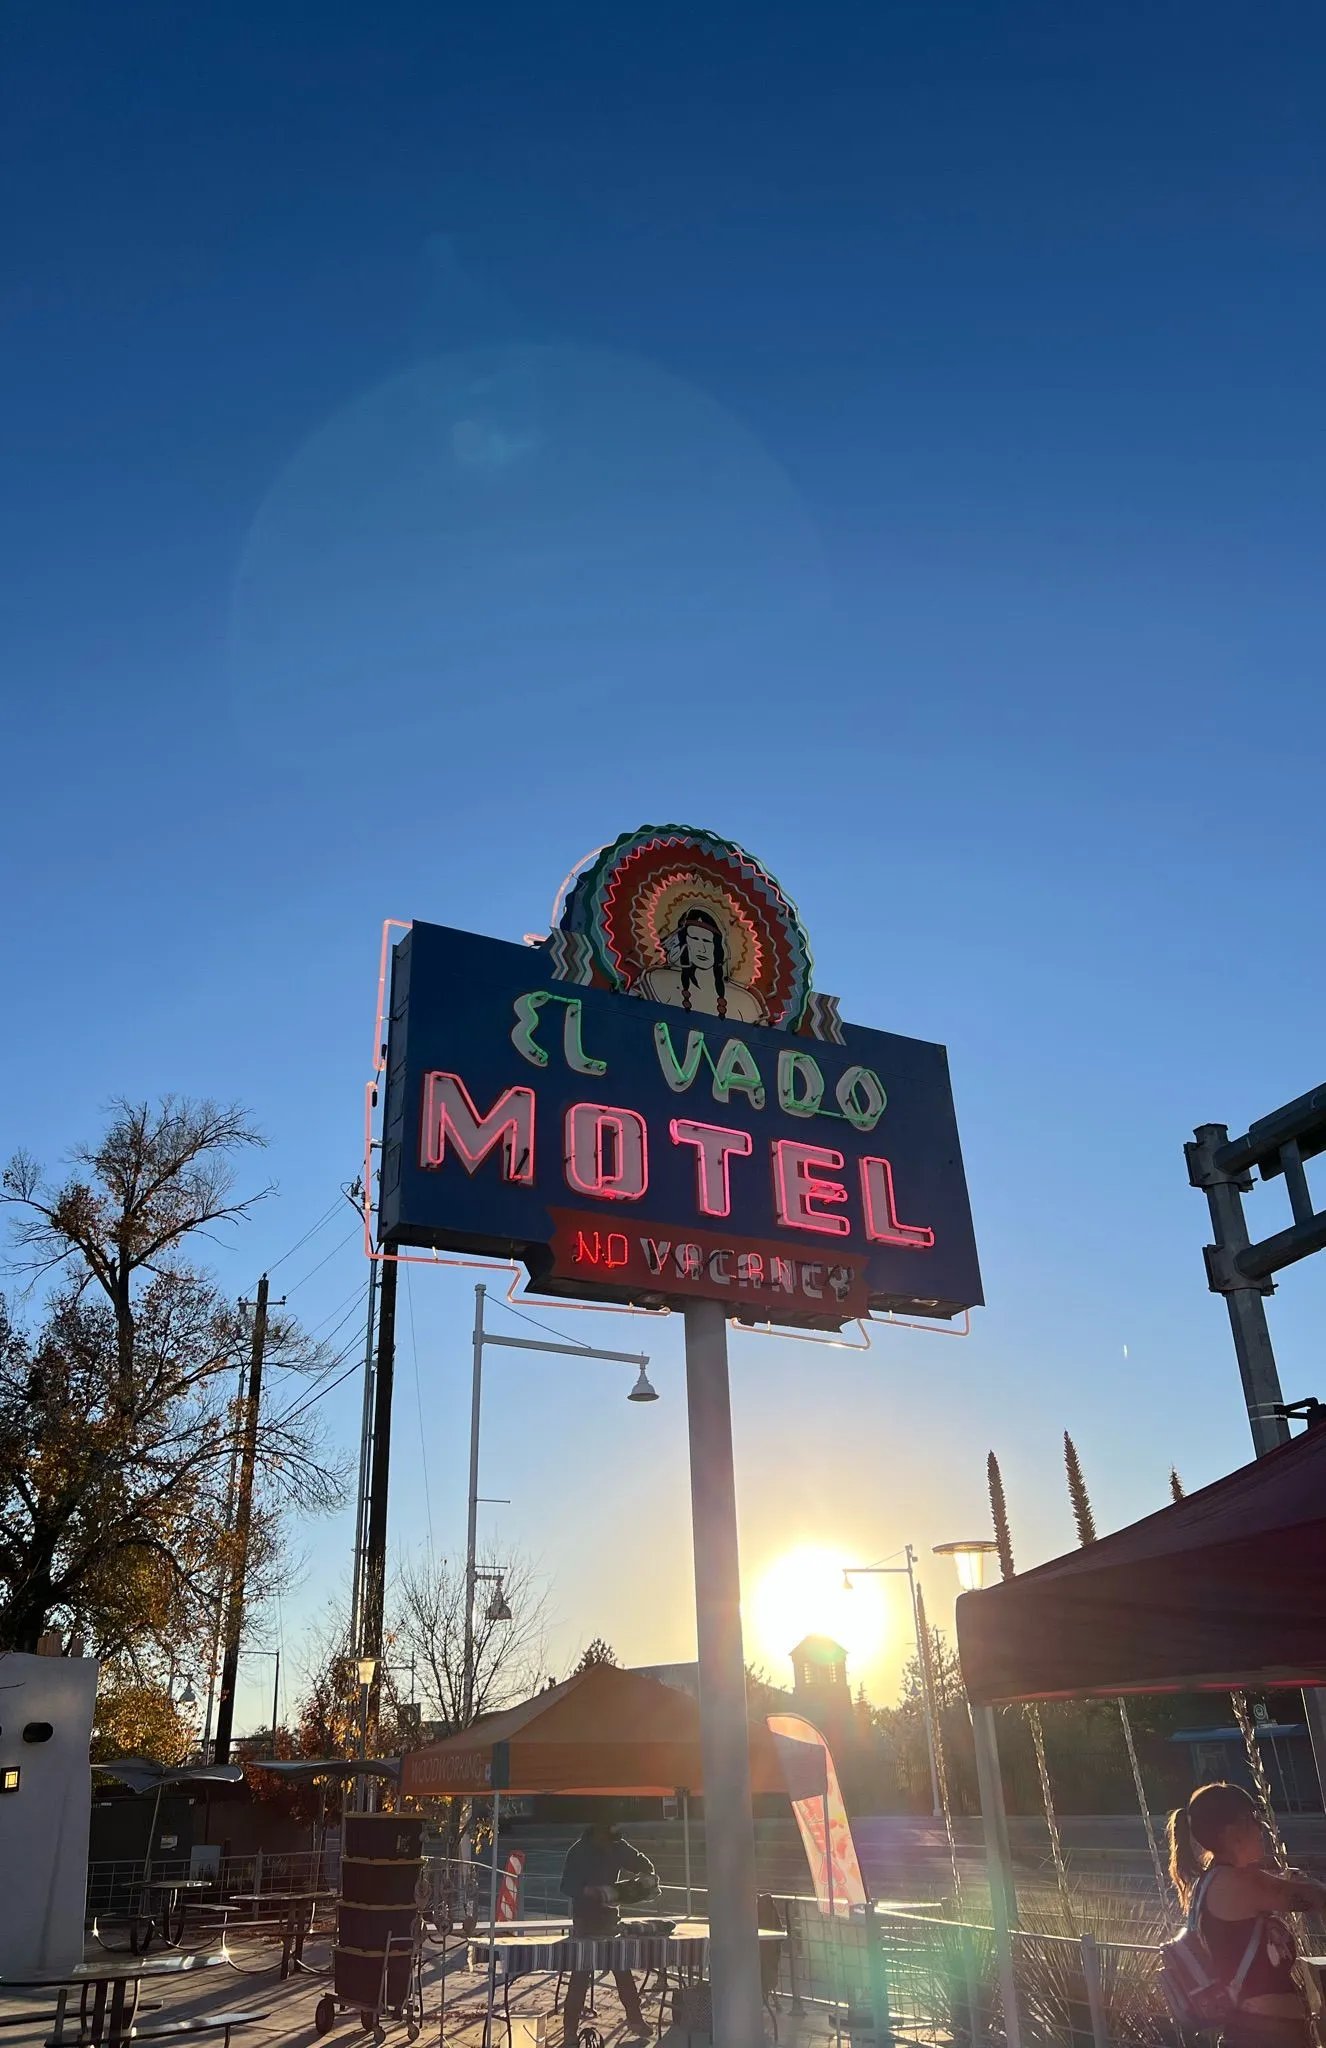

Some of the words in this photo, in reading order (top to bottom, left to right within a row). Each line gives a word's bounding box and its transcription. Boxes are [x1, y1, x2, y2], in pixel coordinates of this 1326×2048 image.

[511, 991, 606, 1075] EL
[654, 1022, 888, 1131] VADO
[420, 1071, 934, 1247] MOTEL
[574, 1231, 628, 1268] NO
[639, 1237, 855, 1302] VACANCY
